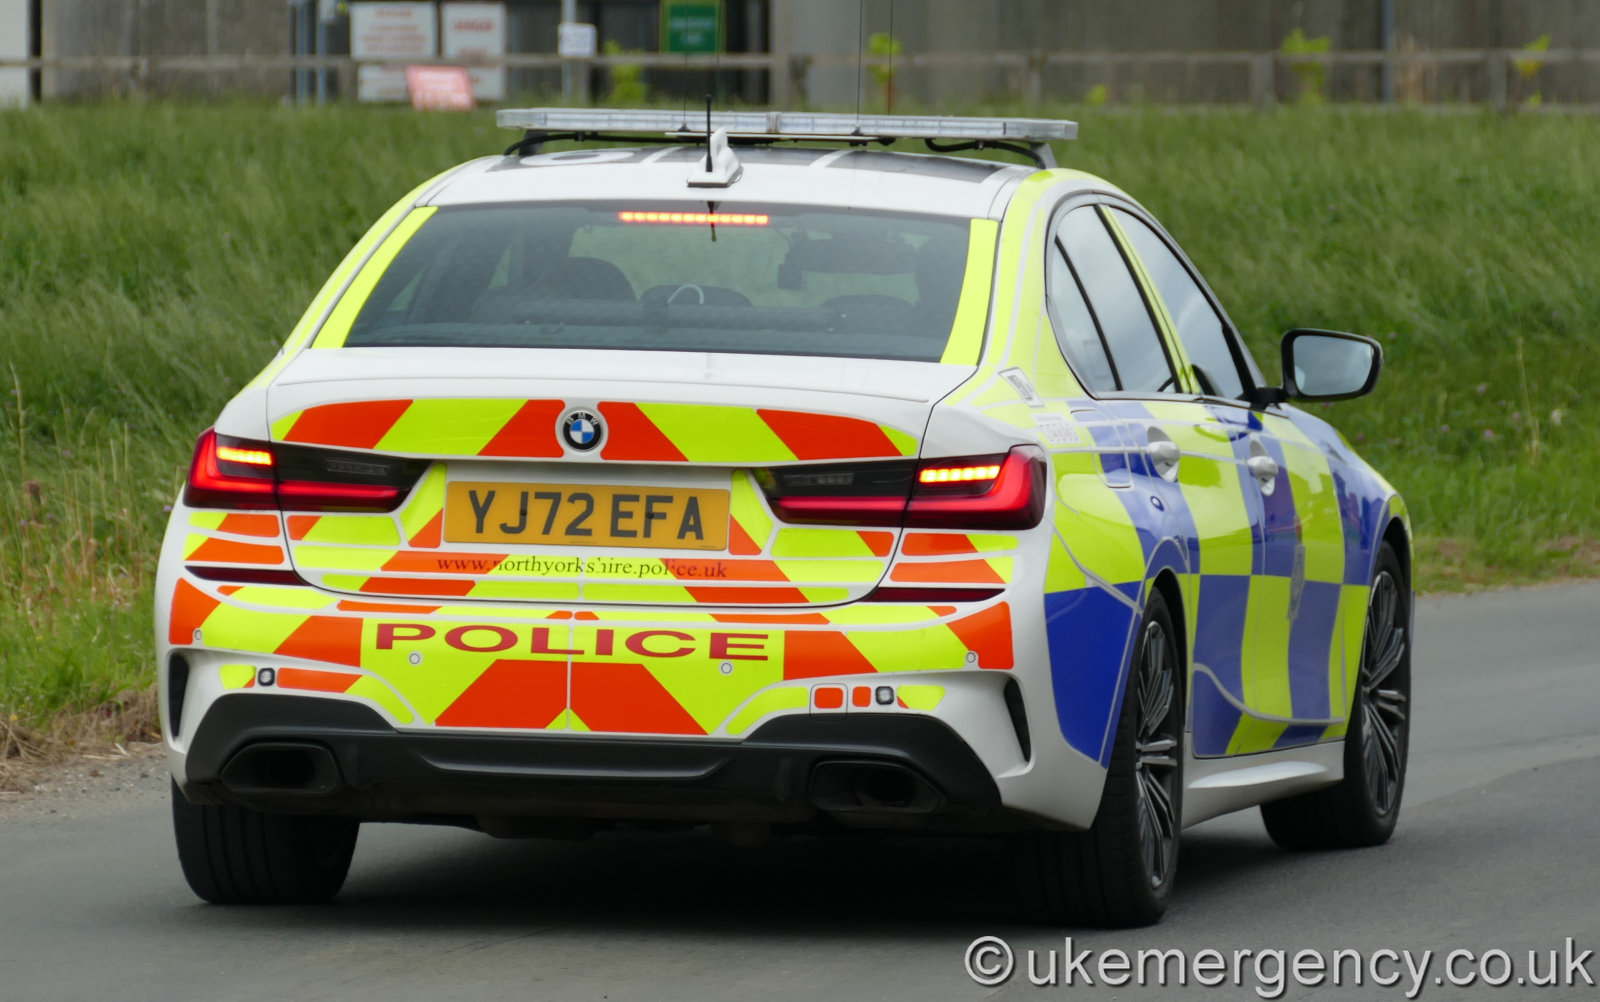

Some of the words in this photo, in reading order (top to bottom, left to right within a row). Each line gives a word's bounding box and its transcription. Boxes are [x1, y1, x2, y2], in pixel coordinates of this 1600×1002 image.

[566, 411, 599, 425] BMW
[468, 490, 595, 537] YJ72
[609, 493, 704, 540] EFA
[437, 555, 728, 579] www.northyorkshire.police.uk
[376, 623, 769, 661] POLICE
